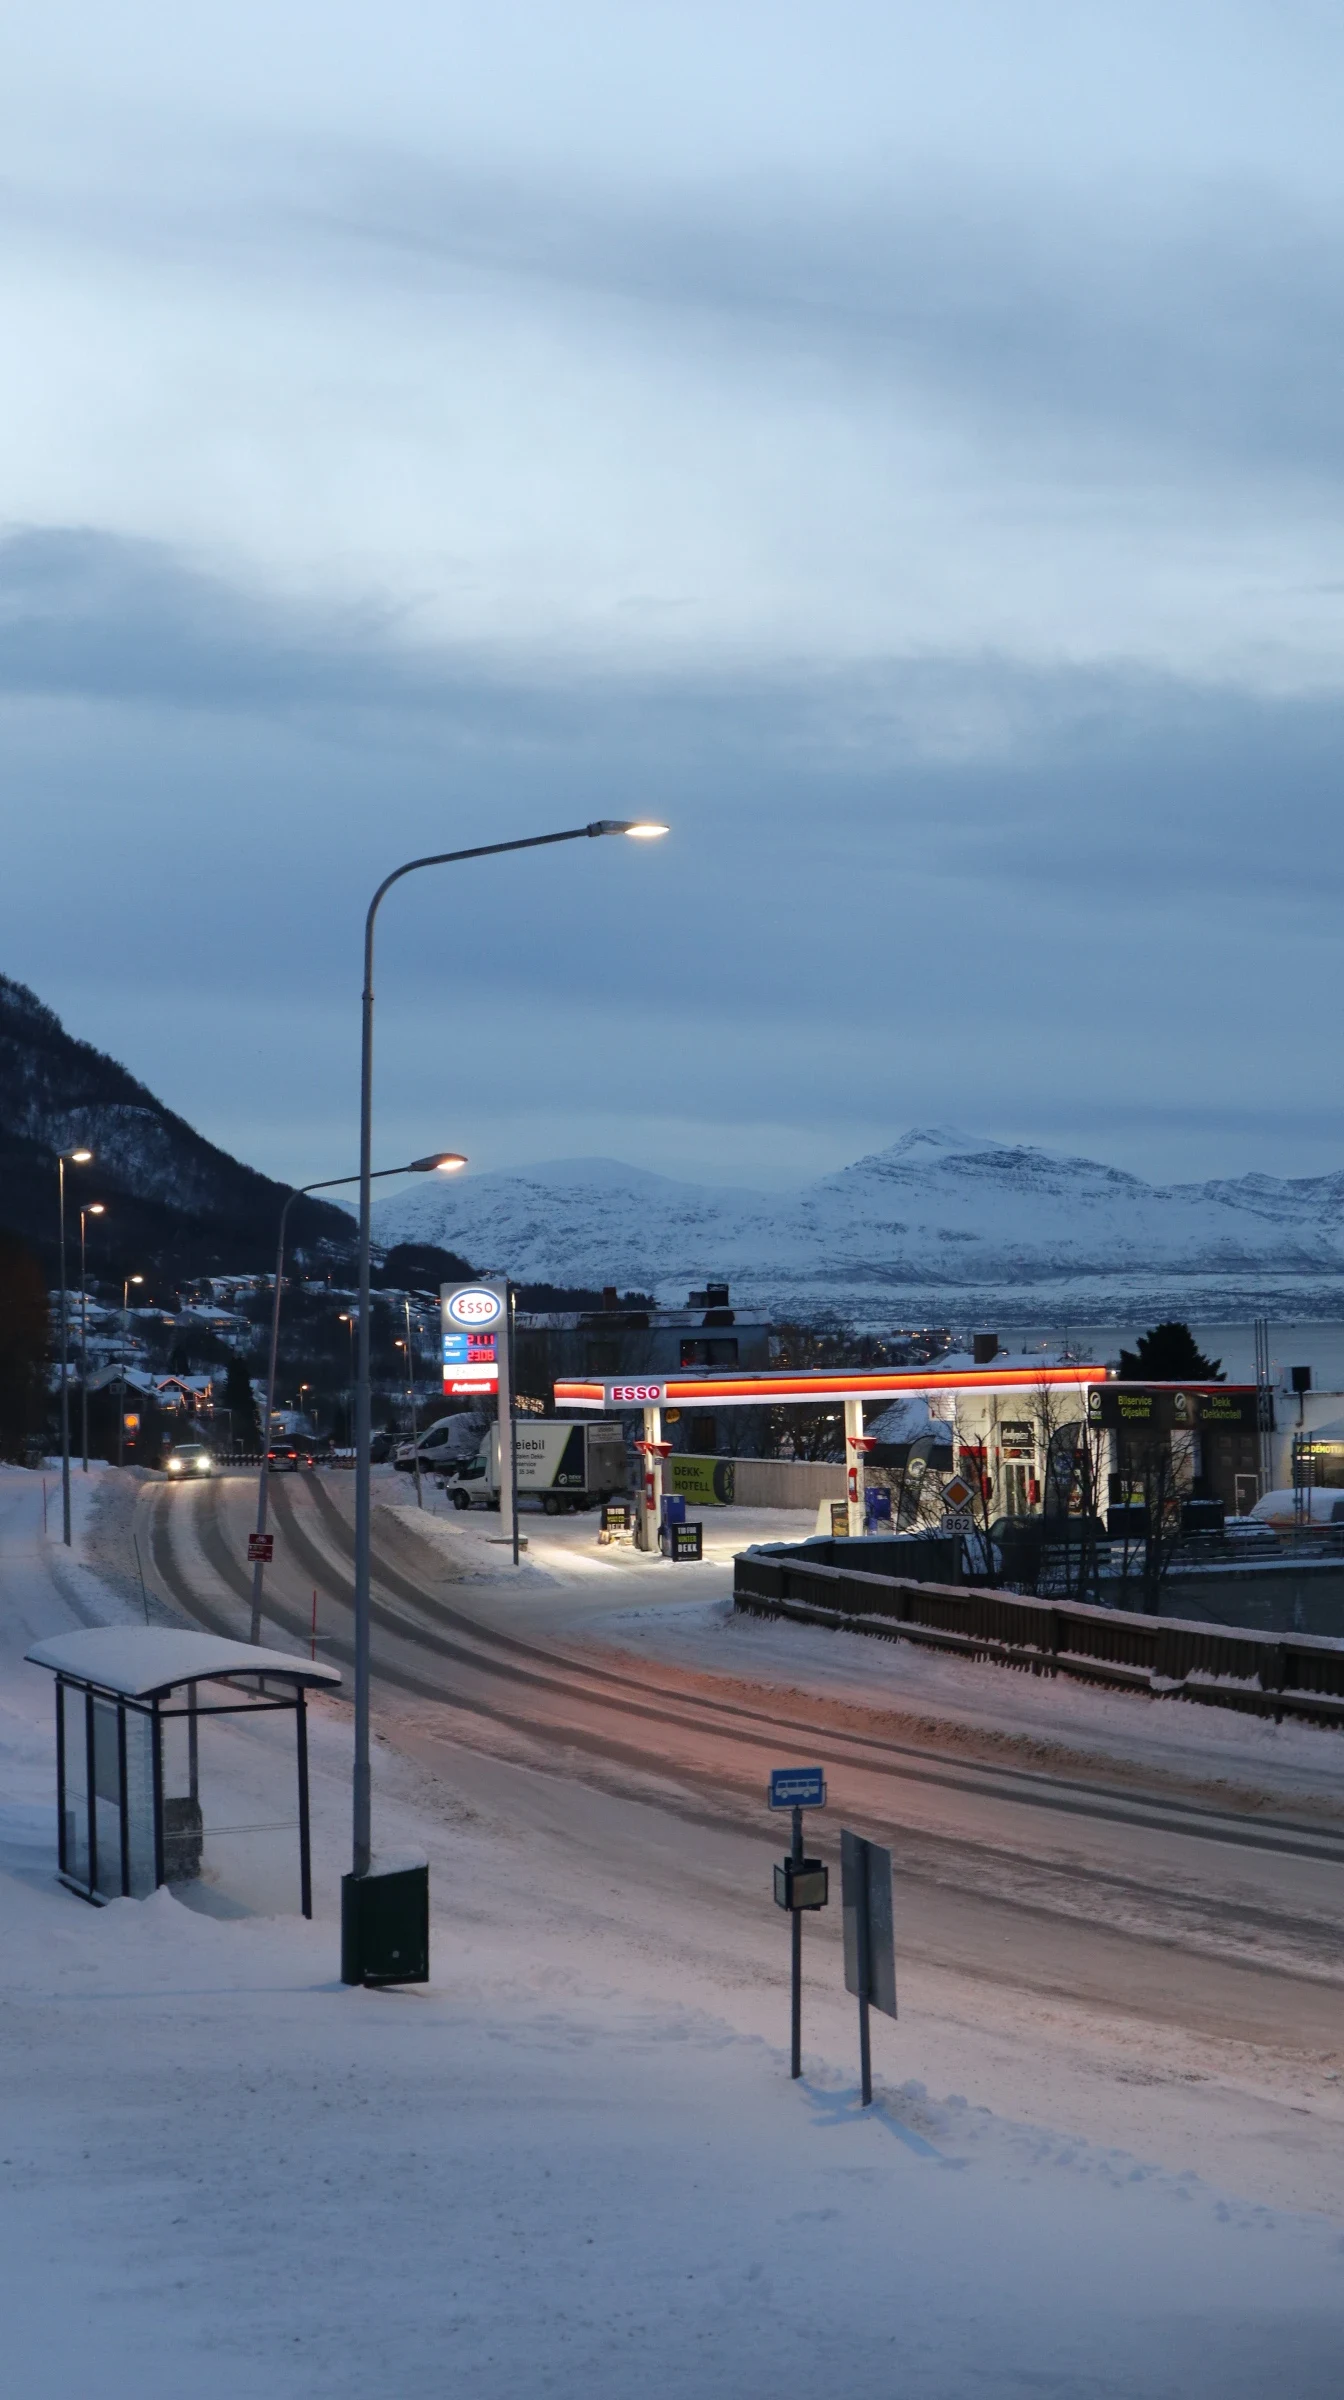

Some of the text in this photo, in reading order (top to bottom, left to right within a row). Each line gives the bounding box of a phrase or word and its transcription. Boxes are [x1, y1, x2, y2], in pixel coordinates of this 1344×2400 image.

[458, 1300, 493, 1313] Esso
[452, 1382, 491, 1392] Automat
[612, 1386, 660, 1401] ESSO
[1118, 1396, 1152, 1405] Bilservice
[1212, 1397, 1231, 1407] Dekk
[1202, 1409, 1242, 1419] Dekkhotell
[674, 1466, 704, 1477] DEKK-
[674, 1480, 711, 1492] HOTELL
[945, 1518, 970, 1530] 862
[678, 1543, 698, 1553] DEKK
